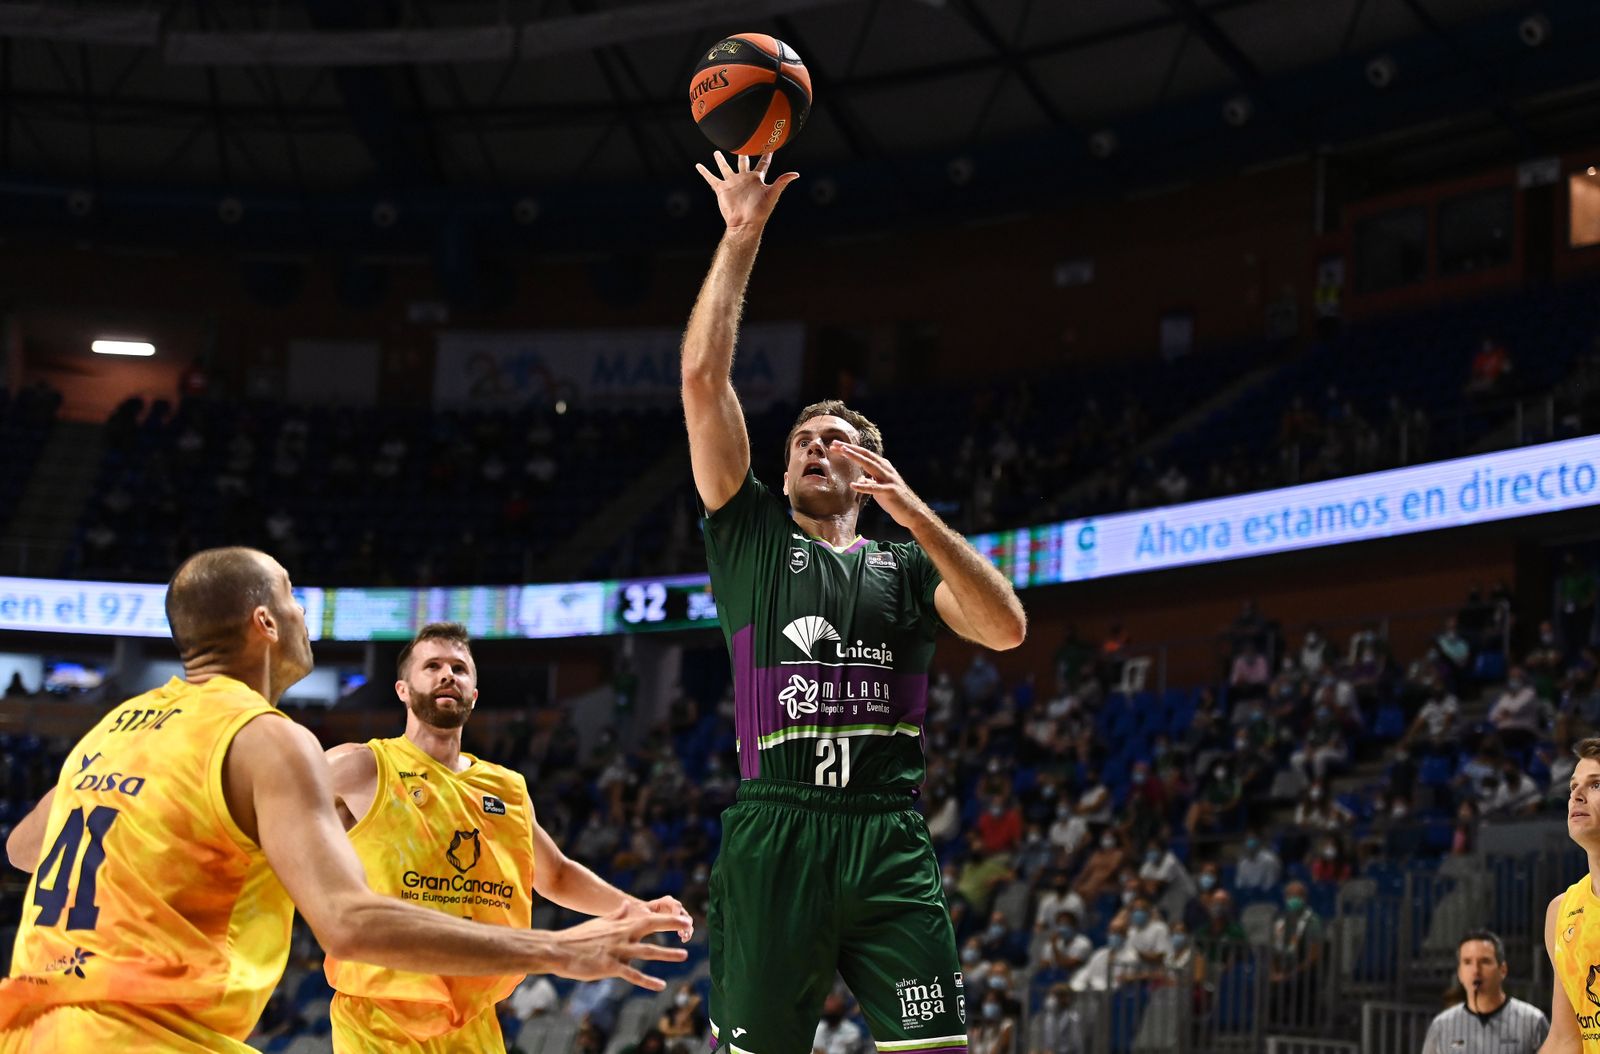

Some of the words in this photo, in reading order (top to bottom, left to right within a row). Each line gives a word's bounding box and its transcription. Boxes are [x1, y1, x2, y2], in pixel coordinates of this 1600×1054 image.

[1135, 518, 1231, 560] Ahora
[1243, 495, 1390, 547] estamos
[1402, 486, 1446, 519] en
[1458, 461, 1598, 512] directo
[1, 592, 44, 622] en
[54, 592, 87, 624] el
[623, 582, 667, 623] 32
[836, 640, 893, 665] Unicaja
[822, 681, 889, 700] MLAGA
[852, 705, 858, 715] y
[815, 737, 850, 788] 21
[33, 805, 120, 931] 41
[401, 889, 419, 901] Isla
[896, 979, 917, 988] sabor
[896, 987, 904, 996] a
[905, 976, 944, 1001] má
[900, 998, 946, 1020] laga
